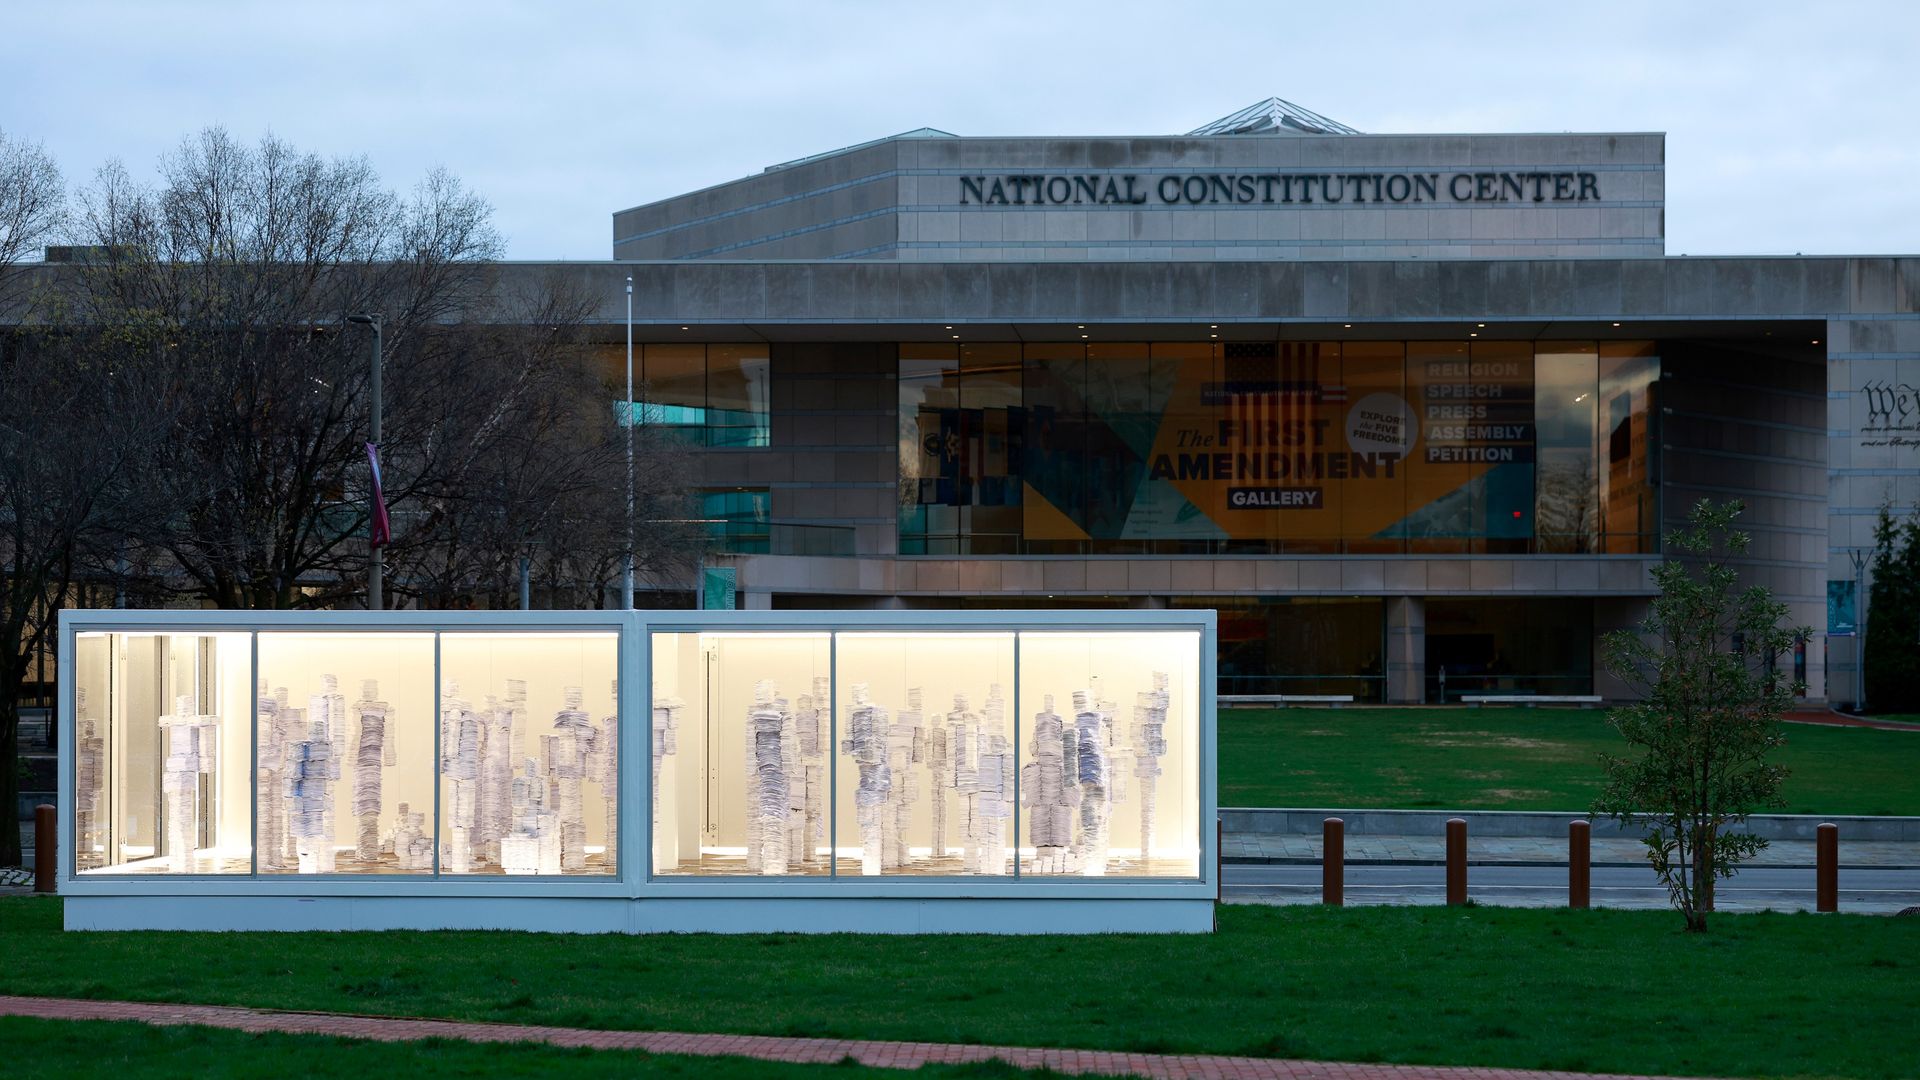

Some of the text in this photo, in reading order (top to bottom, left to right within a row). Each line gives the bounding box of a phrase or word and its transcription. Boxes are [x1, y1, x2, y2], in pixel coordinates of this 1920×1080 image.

[960, 172, 1600, 204] NATIONAL CONSTITUTION CENTER
[1428, 363, 1519, 377] RELIGION
[1428, 384, 1503, 398] SPEECH
[1360, 411, 1406, 425] EXPLORE
[1428, 405, 1488, 419] PRESS
[1177, 420, 1330, 447] The FIRST
[1359, 421, 1399, 435] the FIVE
[1430, 425, 1525, 440] ASSEMBLY
[1353, 430, 1407, 446] FREEDOMS
[1428, 447, 1513, 461] PETITION
[1149, 452, 1401, 480] AMENDMENT
[1232, 490, 1317, 506] GALLERY
